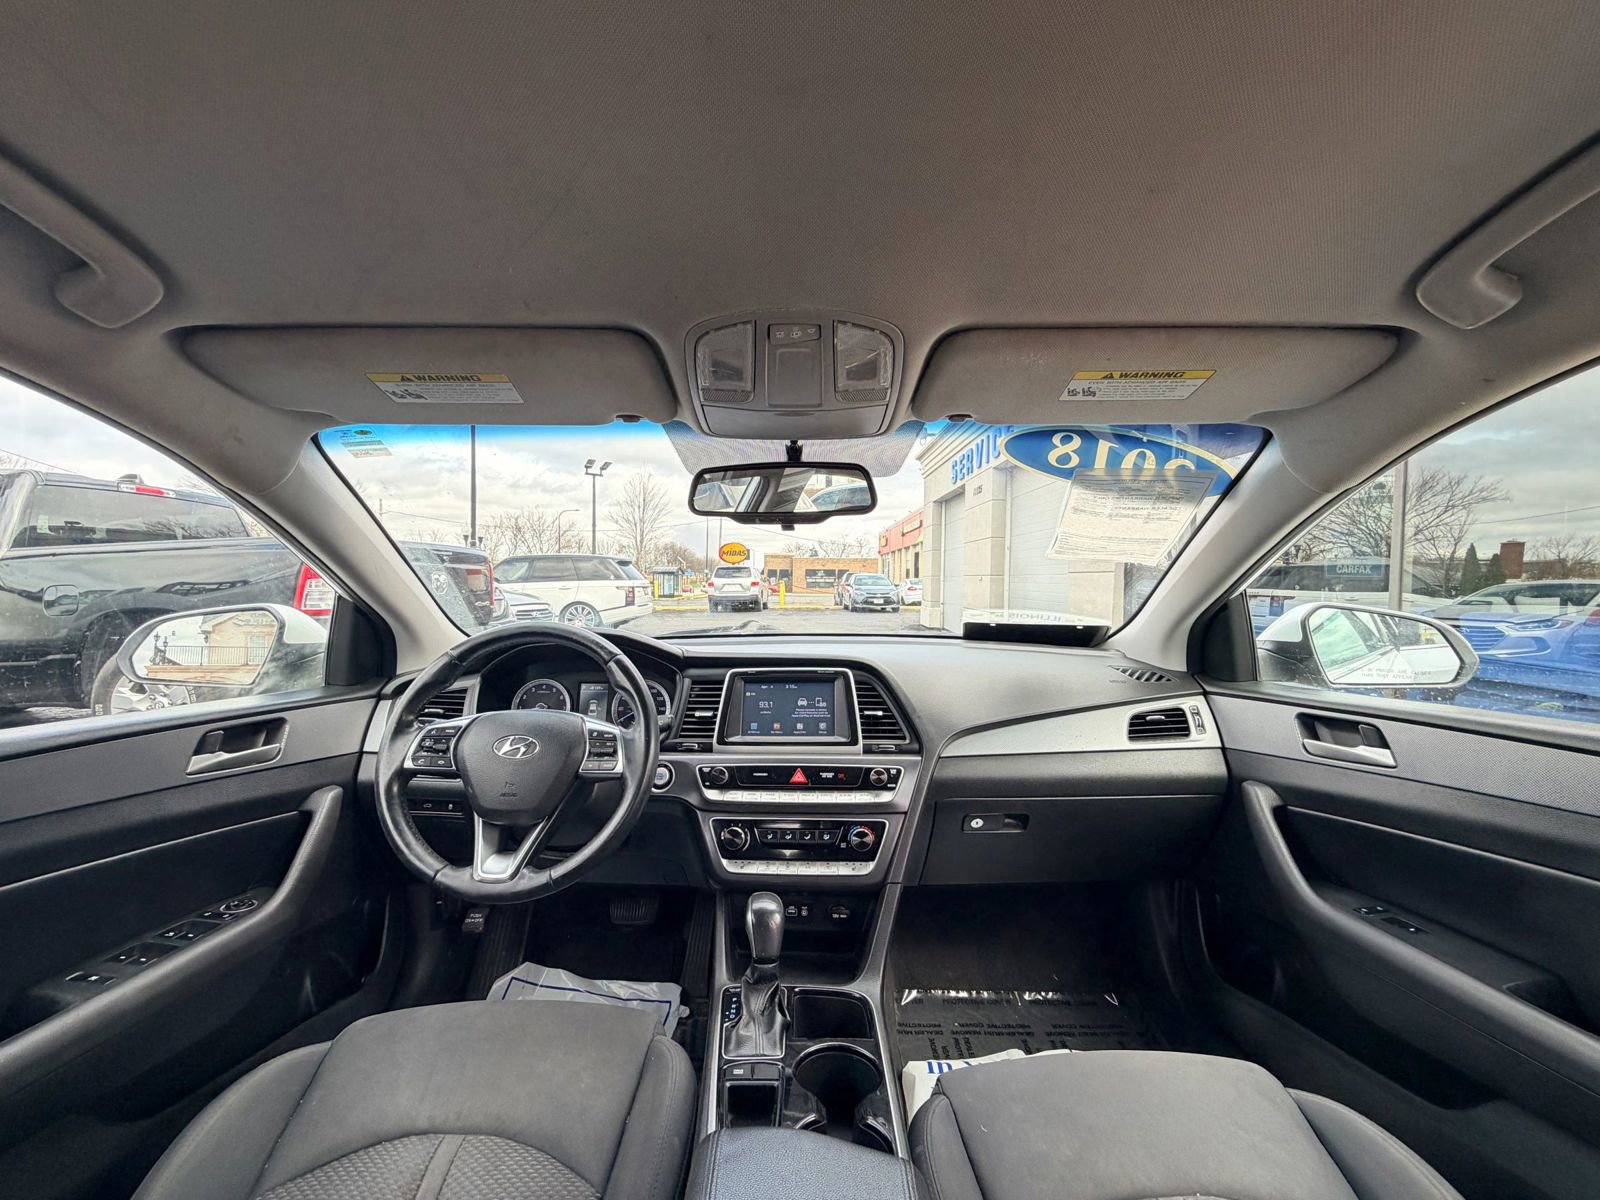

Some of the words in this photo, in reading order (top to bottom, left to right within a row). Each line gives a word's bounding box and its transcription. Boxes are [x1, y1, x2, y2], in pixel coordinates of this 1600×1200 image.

[413, 374, 482, 382] WARNING
[1118, 371, 1186, 379] WARNING
[1336, 564, 1372, 574] CARFAX
